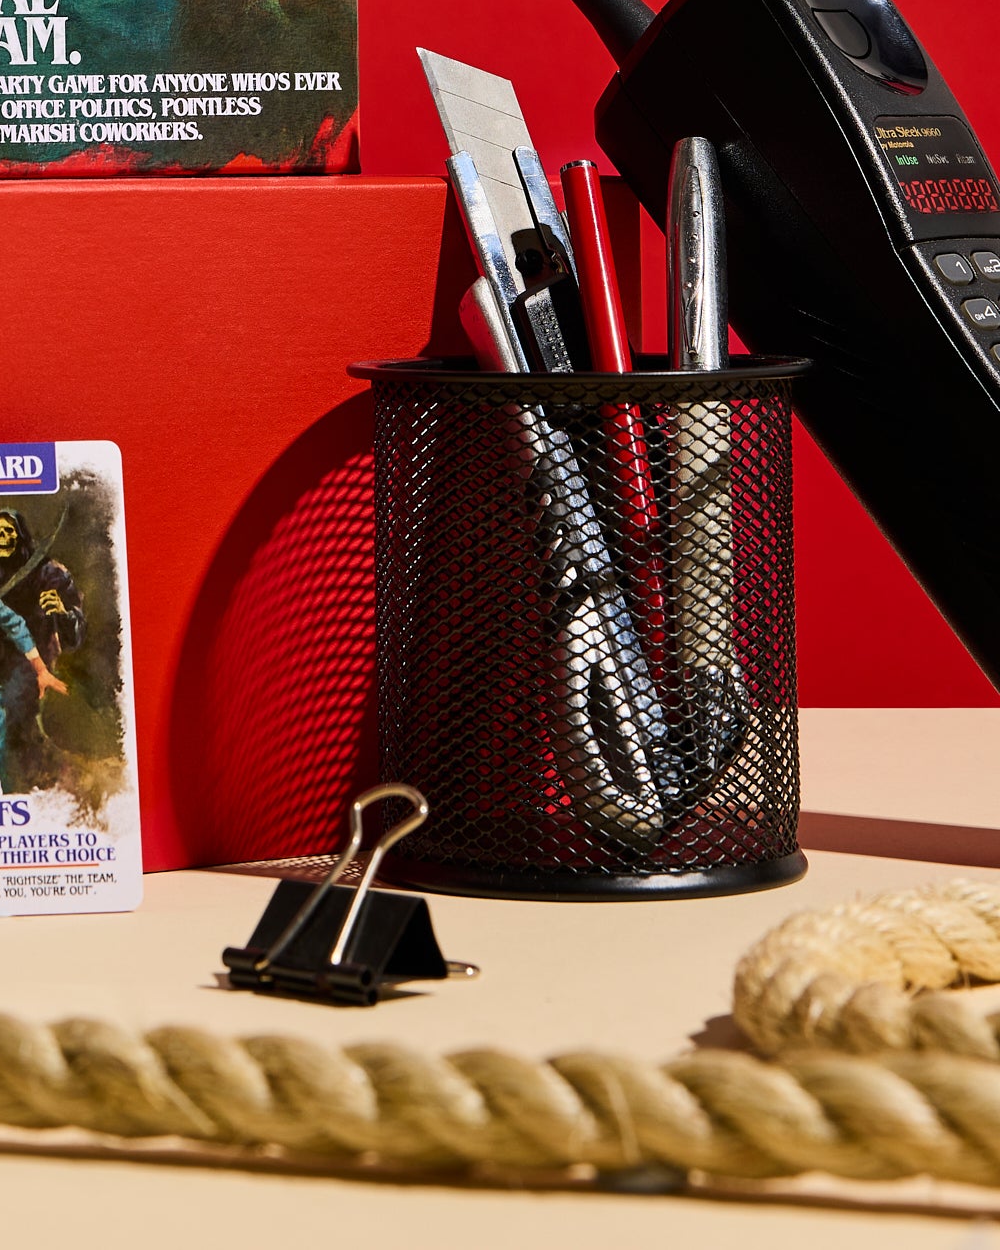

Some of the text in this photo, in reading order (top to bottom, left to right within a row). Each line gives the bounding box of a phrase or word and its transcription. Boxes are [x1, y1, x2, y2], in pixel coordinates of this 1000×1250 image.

[47, 73, 106, 95] GAME
[108, 73, 150, 94] FOR
[150, 72, 229, 93] ANYONE
[229, 71, 292, 93] WHO'S
[293, 71, 343, 92] EVER
[0, 99, 66, 120] OFFICE
[68, 98, 158, 120] POLITICS,
[160, 96, 263, 117] POINTLESS
[79, 121, 205, 143] COWORKERS.
[896, 126, 922, 138] Sleek
[955, 260, 967, 275] 1
[984, 305, 997, 319] 4
[75, 833, 97, 847] TO
[0, 849, 49, 864] THEIR
[55, 847, 116, 862] CHOICE
[64, 873, 85, 884] THE
[87, 872, 118, 884] TEAM,
[31, 885, 66, 897] YOU'RE
